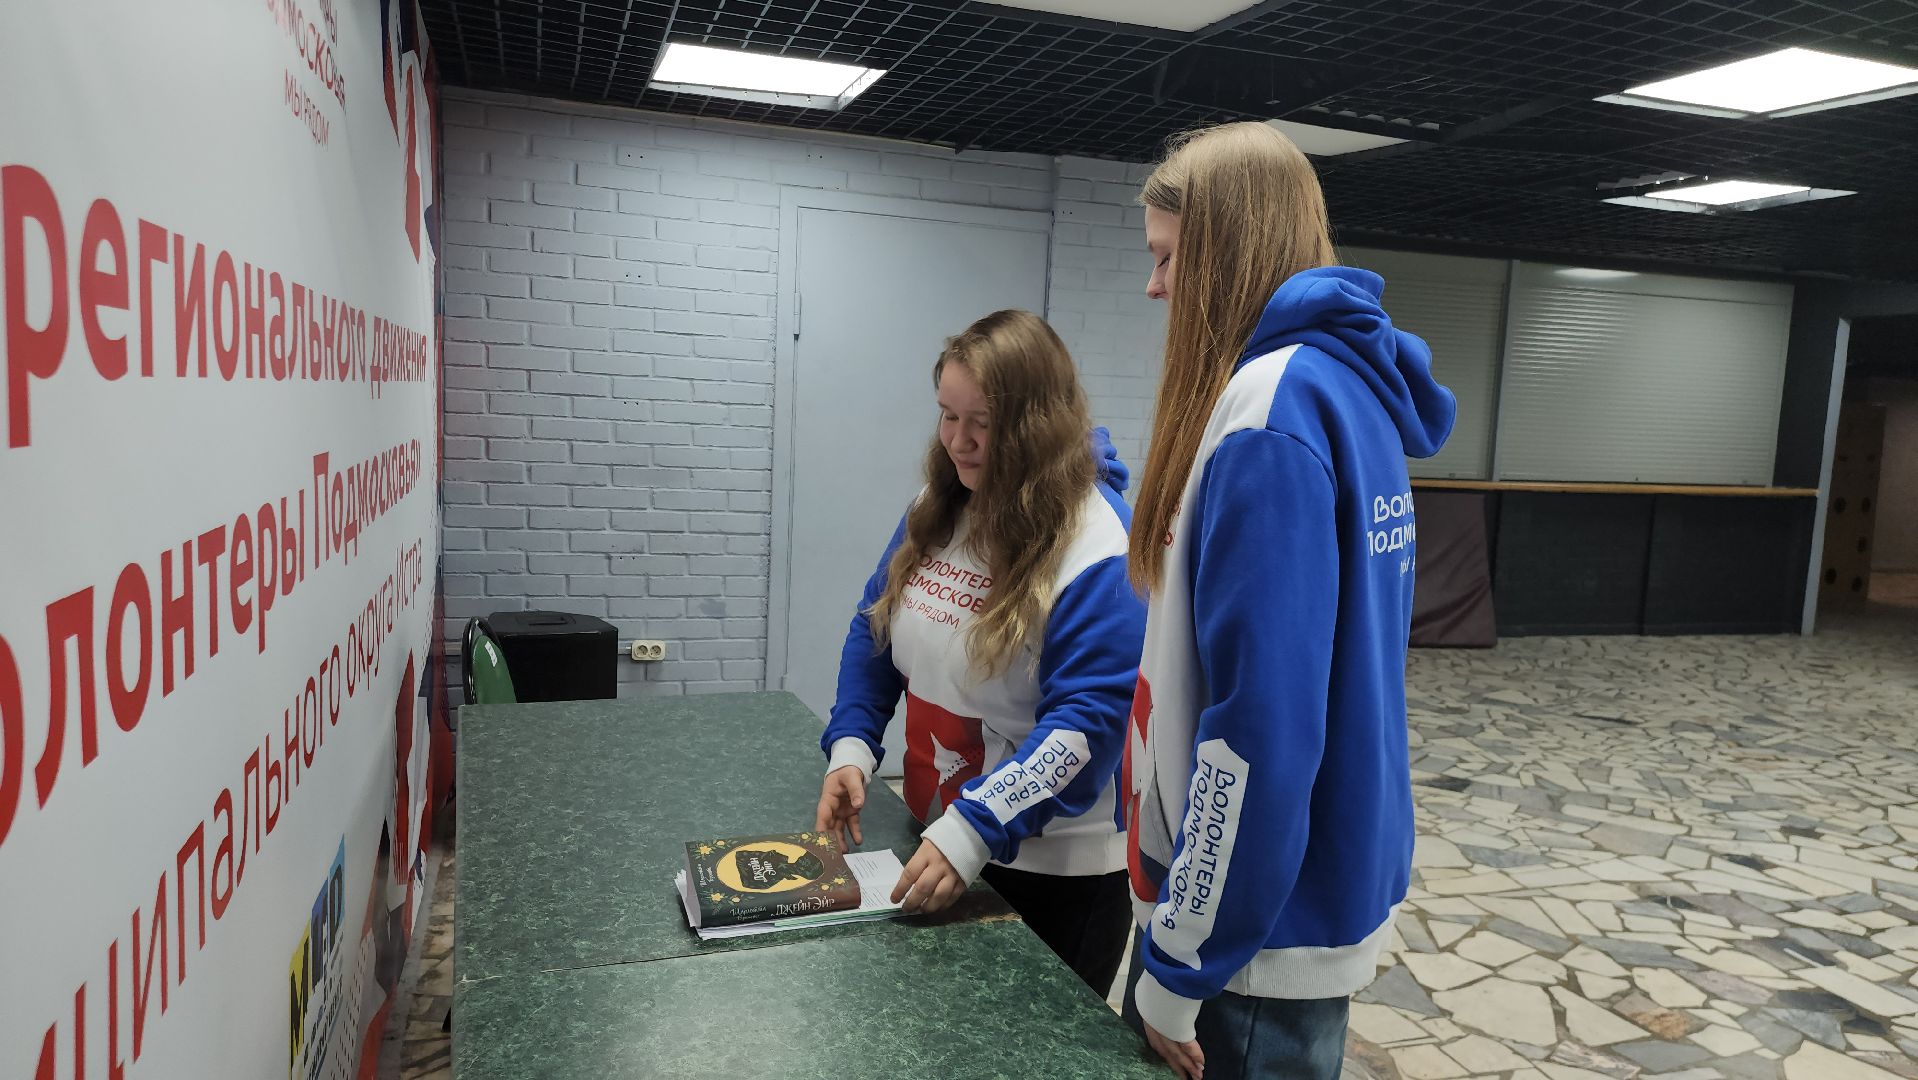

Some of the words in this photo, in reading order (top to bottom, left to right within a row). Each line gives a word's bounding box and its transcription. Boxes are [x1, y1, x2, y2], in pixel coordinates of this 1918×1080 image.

[2, 164, 366, 448] регионального
[370, 316, 428, 400] движения
[916, 603, 960, 629] РЯДОМ
[920, 554, 993, 590] ОЛОНТЕР
[34, 643, 342, 1080] ципального
[346, 573, 394, 699] округа
[395, 537, 422, 618] Истра
[1189, 768, 1236, 916] ВОЛОНТЕРЫ
